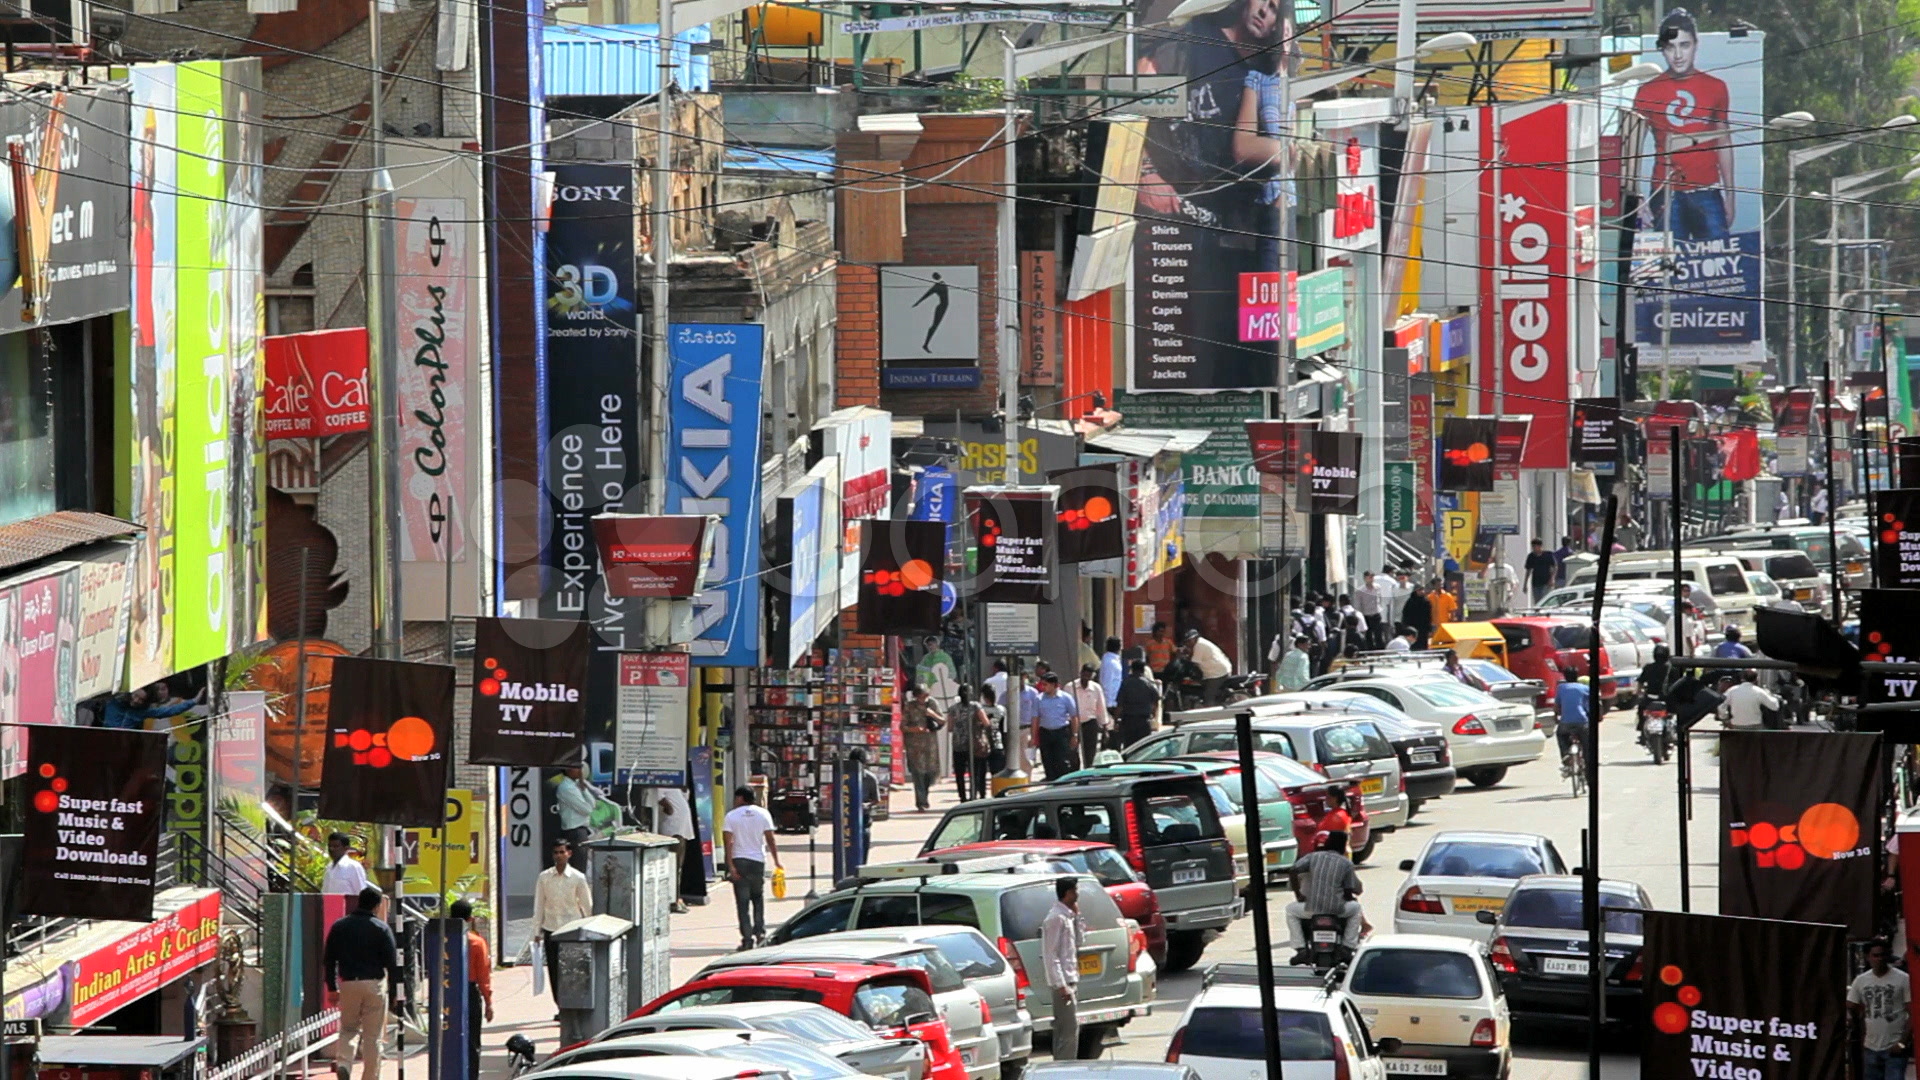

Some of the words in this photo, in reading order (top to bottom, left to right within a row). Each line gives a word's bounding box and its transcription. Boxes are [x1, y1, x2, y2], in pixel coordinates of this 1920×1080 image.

[550, 185, 625, 202] SONY
[79, 200, 94, 239] M
[1152, 225, 1179, 236] Shirts
[1152, 241, 1193, 252] Trousers
[1152, 258, 1188, 267] T-Shirts
[555, 264, 619, 306] 3D
[1152, 273, 1184, 285] Cargos
[1152, 290, 1188, 299] Denims
[567, 310, 604, 321] world
[1152, 305, 1182, 317] Capris
[547, 327, 587, 337] Created
[589, 327, 601, 338] by
[604, 327, 629, 338] Sony
[1152, 321, 1175, 333] Tops
[1152, 338, 1183, 347] Tunics
[1152, 354, 1197, 364] Sweaters
[930, 372, 973, 383] TERRAIN
[1152, 370, 1187, 380] Jackets
[203, 206, 229, 632] adida
[325, 411, 367, 427] COFFEE
[596, 393, 623, 469] Here
[1193, 464, 1244, 485] BANK
[1312, 466, 1357, 479] Mobile
[1312, 478, 1332, 490] TV
[557, 434, 591, 612] Experience
[1450, 517, 1466, 537] P
[1025, 536, 1043, 546] fast
[1899, 531, 1920, 541] Sup
[1026, 546, 1034, 555] &
[1899, 551, 1920, 561] Vid
[995, 555, 1024, 564] Video
[623, 655, 639, 663] PAY
[630, 670, 642, 684] P
[499, 682, 580, 703] Mobile
[1884, 679, 1918, 697] TV
[498, 704, 533, 723] TV
[58, 794, 108, 813] Super
[109, 798, 144, 814] fast
[510, 766, 531, 847] SON
[58, 812, 108, 829] Music
[111, 816, 125, 831] &
[57, 829, 106, 846] Video
[55, 846, 148, 866] Downloads
[1832, 850, 1855, 860] Now
[1856, 847, 1871, 857] 3G
[73, 967, 121, 1006] Indian
[126, 950, 156, 980] Arts
[160, 936, 172, 961] &
[175, 917, 218, 952] Crafts
[1691, 1009, 1765, 1036] Super
[1768, 1017, 1818, 1040] fast
[1690, 1034, 1766, 1060] Music
[1772, 1043, 1792, 1062] &
[1400, 1063, 1410, 1072] 03
[1690, 1058, 1762, 1080] Video
